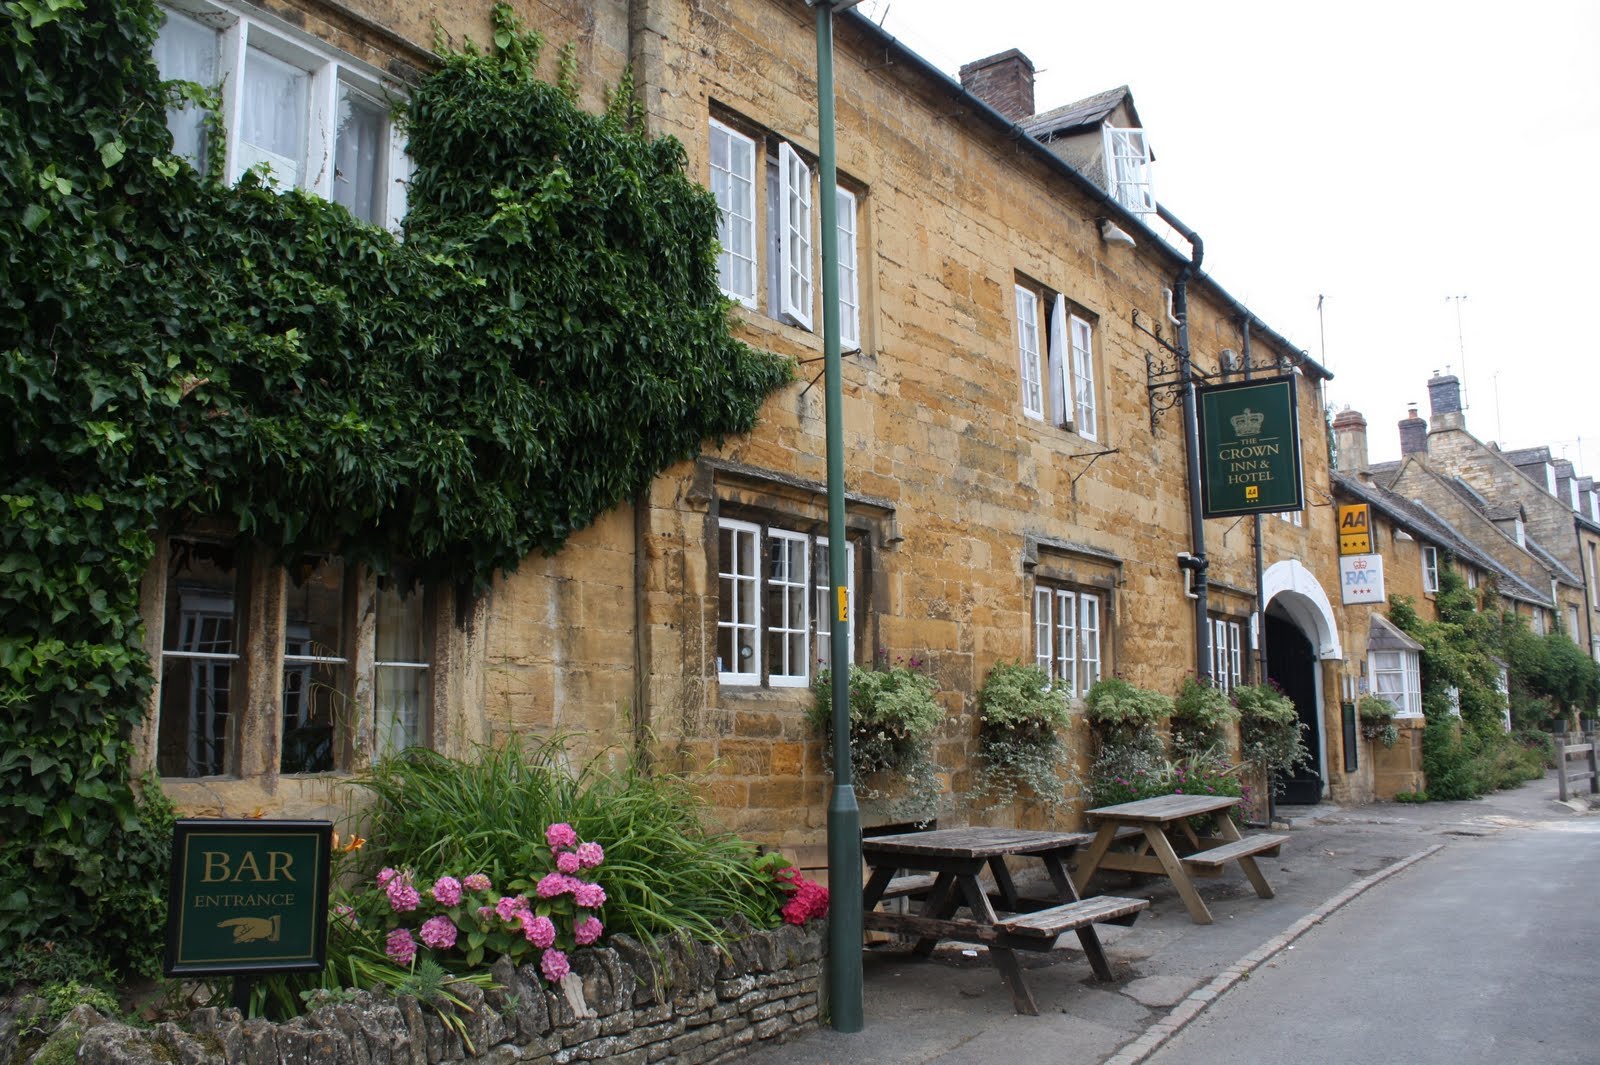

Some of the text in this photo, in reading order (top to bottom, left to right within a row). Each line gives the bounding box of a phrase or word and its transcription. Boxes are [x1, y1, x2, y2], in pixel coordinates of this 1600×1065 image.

[1219, 444, 1279, 460] CROWN
[1231, 460, 1269, 472] INN &
[1229, 471, 1274, 484] HOTEL
[1342, 511, 1366, 529] AA
[200, 851, 296, 882] BAR
[194, 894, 295, 907] ENTRANCE
